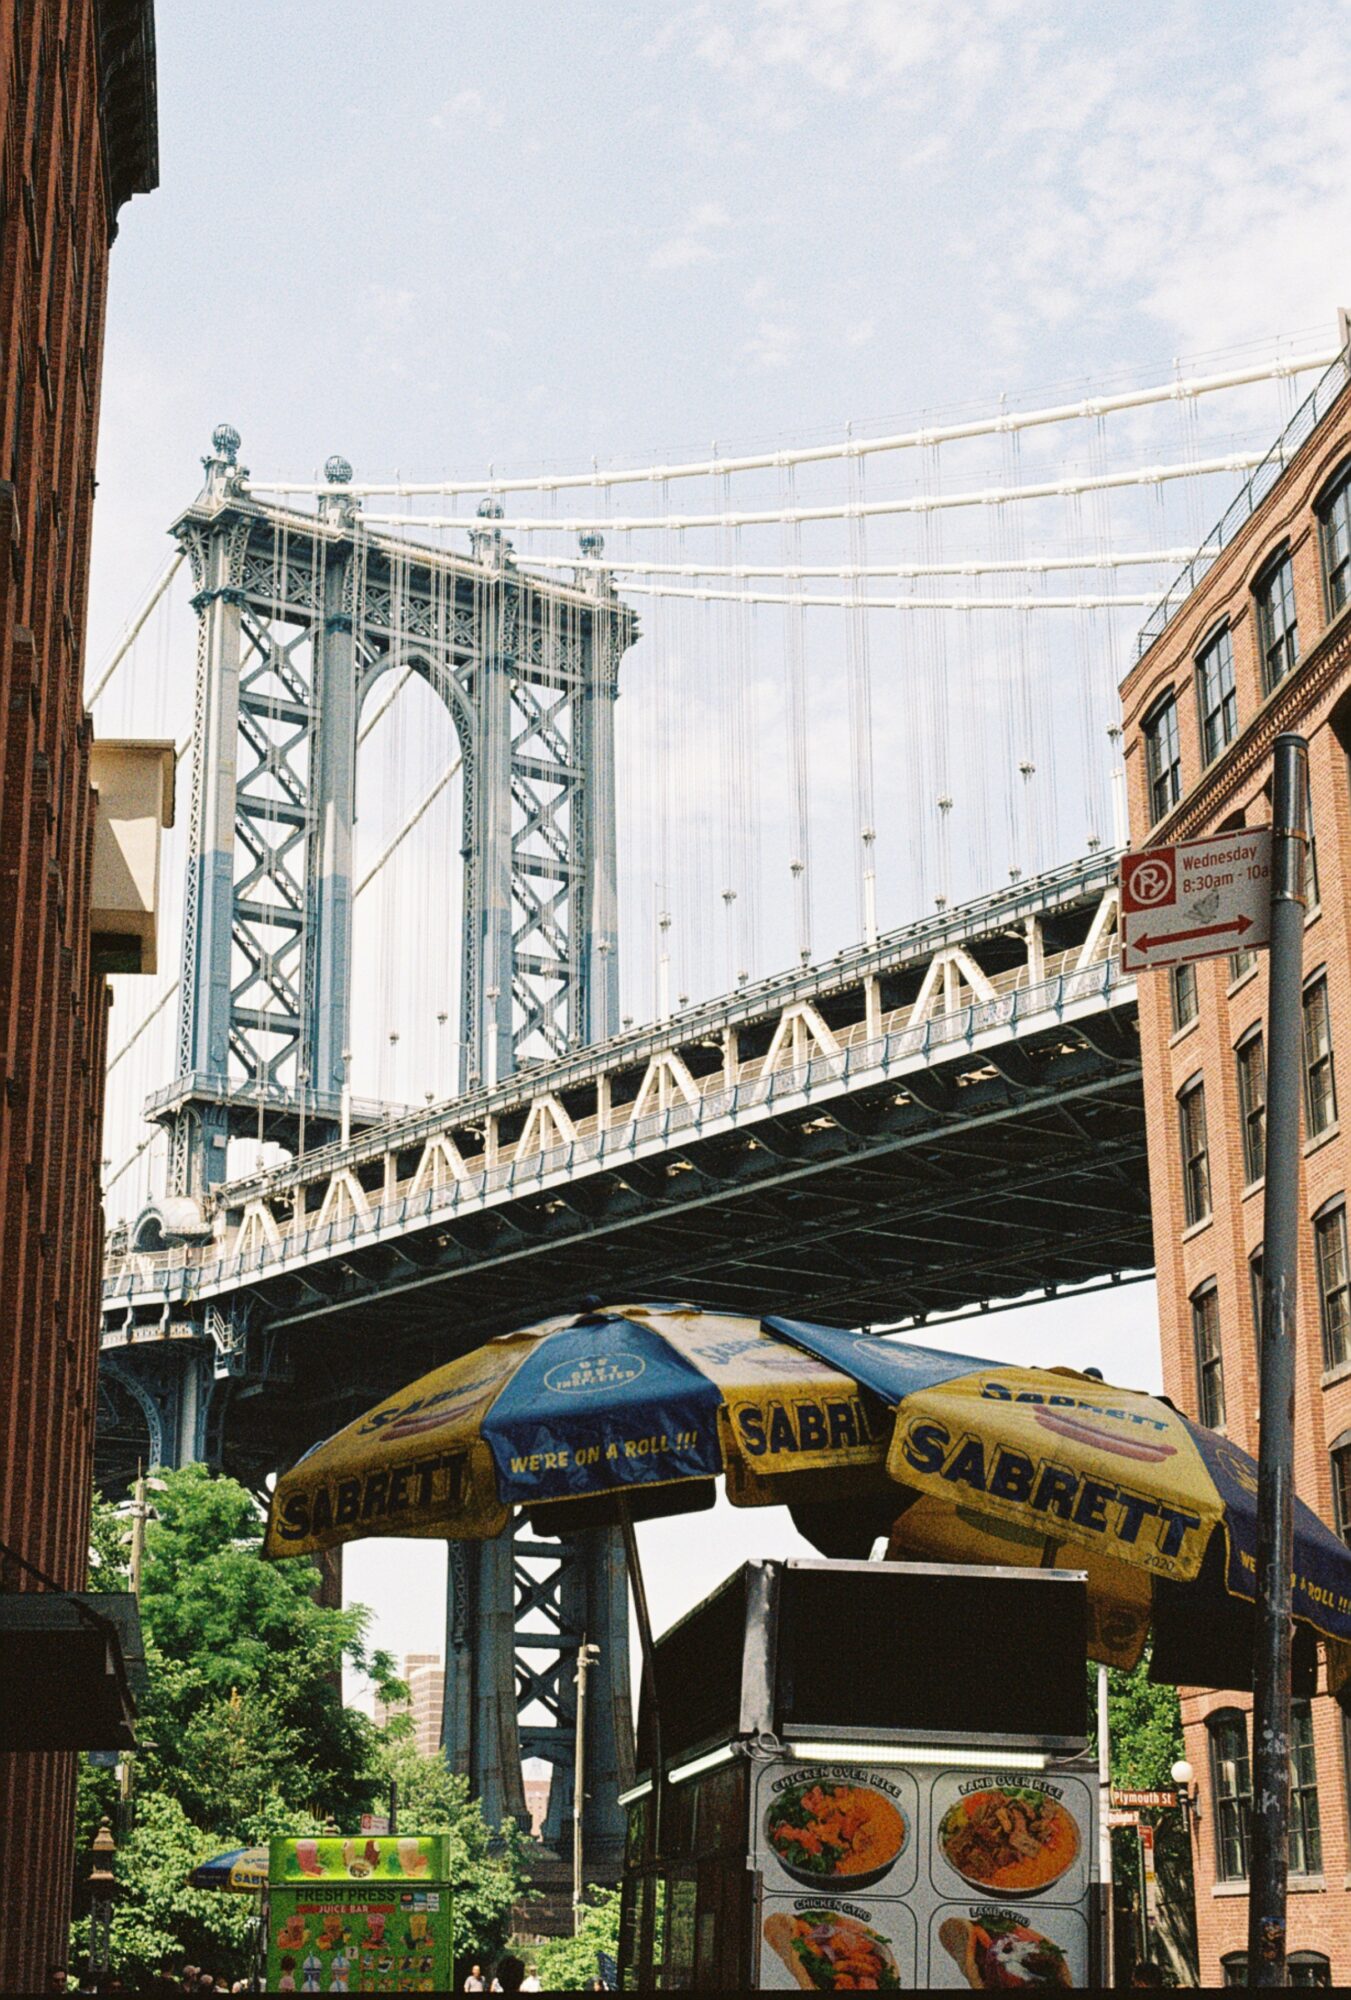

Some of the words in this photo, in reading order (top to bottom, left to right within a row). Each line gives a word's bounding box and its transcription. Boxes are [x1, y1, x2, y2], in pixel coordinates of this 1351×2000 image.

[1182, 846, 1257, 871] Wednesday
[1183, 874, 1233, 893] 8:30am
[1247, 864, 1269, 881] 10a
[978, 1377, 1169, 1432] SABRETT
[510, 1451, 569, 1474] WE'RE
[574, 1446, 600, 1466] ON
[605, 1443, 619, 1459] A
[624, 1435, 670, 1458] ROLL
[676, 1430, 698, 1450] !!!
[276, 1446, 470, 1541] SABRETT
[902, 1416, 1200, 1557] SABRETT
[1144, 1552, 1176, 1572] 2020
[1308, 1580, 1335, 1607] ROLL
[771, 1766, 829, 1793] CHICKEN
[831, 1766, 868, 1783] OVER
[870, 1774, 902, 1799] RICE
[958, 1776, 993, 1796] LAMB
[995, 1775, 1030, 1789] OVER
[1032, 1778, 1064, 1800] RICE
[1114, 1787, 1160, 1806] Plymouth
[1161, 1787, 1173, 1805] St
[296, 1888, 343, 1901] FRESH
[349, 1888, 396, 1901] PRESS
[319, 1904, 346, 1914] JUICE
[350, 1904, 369, 1914] BAR
[794, 1897, 842, 1911] CHICKEN
[842, 1902, 872, 1922] GYRO
[969, 1905, 1001, 1918] LAMB
[1001, 1908, 1031, 1928] GYRO
